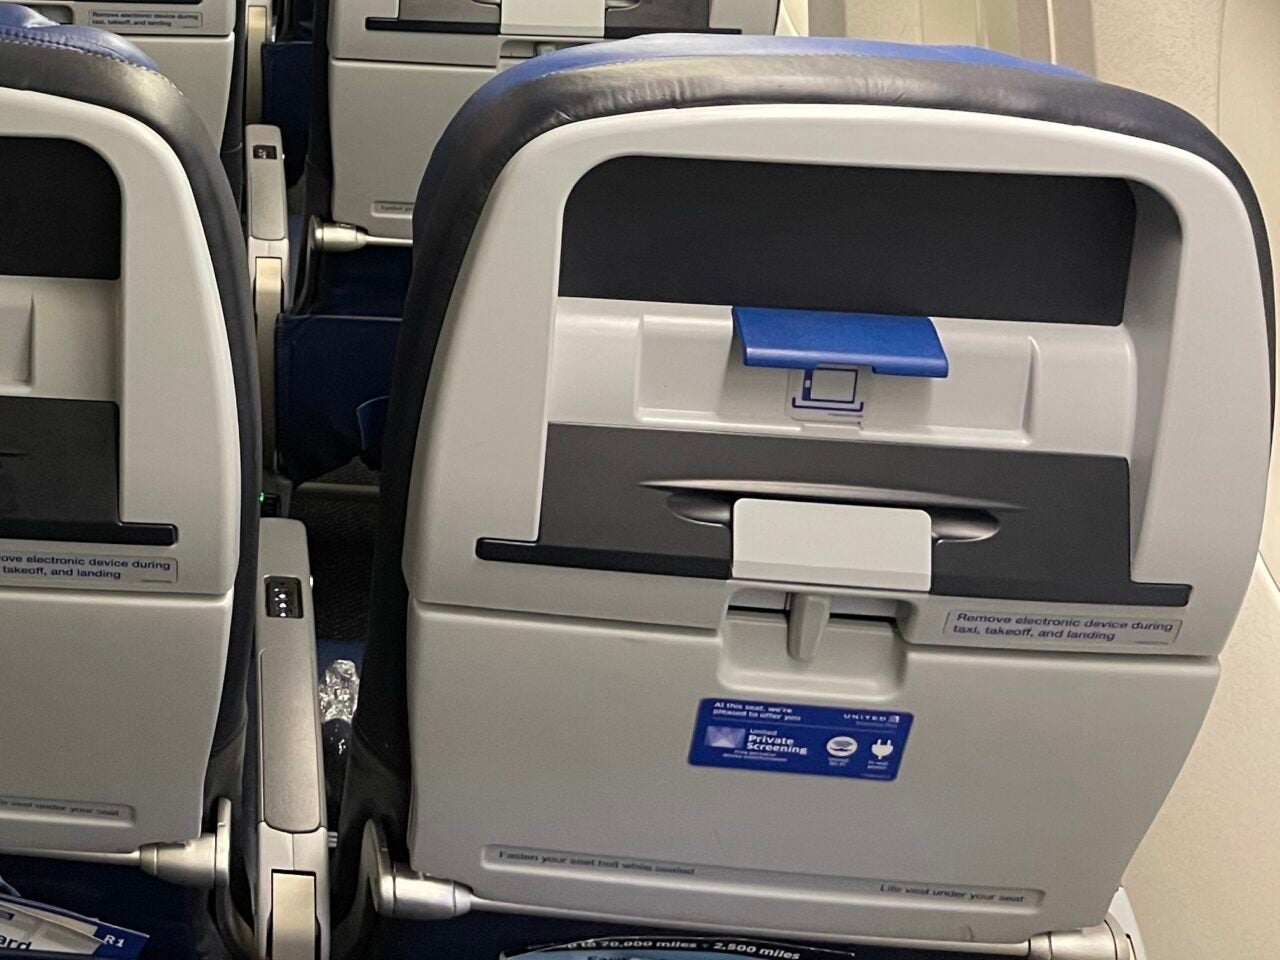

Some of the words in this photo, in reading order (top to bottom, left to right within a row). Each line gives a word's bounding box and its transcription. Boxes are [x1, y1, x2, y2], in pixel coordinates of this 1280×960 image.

[26, 554, 85, 566] electronic
[88, 557, 129, 568] device
[131, 560, 171, 571] during
[3, 566, 47, 577] takeoff,
[50, 568, 73, 577] and
[77, 569, 121, 580] landing
[956, 612, 1012, 624] Remove
[1015, 615, 1081, 627] electronic
[1084, 619, 1129, 629] device
[1131, 621, 1174, 632] during
[953, 625, 980, 635] taxi,
[985, 627, 1034, 638] takeoff,
[1037, 629, 1064, 638] and
[1066, 630, 1116, 641] landing
[843, 713, 887, 722] UNITED
[748, 735, 795, 746] Private
[746, 742, 808, 756] Screening
[104, 933, 126, 948] R1
[656, 940, 697, 948] miles
[759, 947, 801, 960] miles
